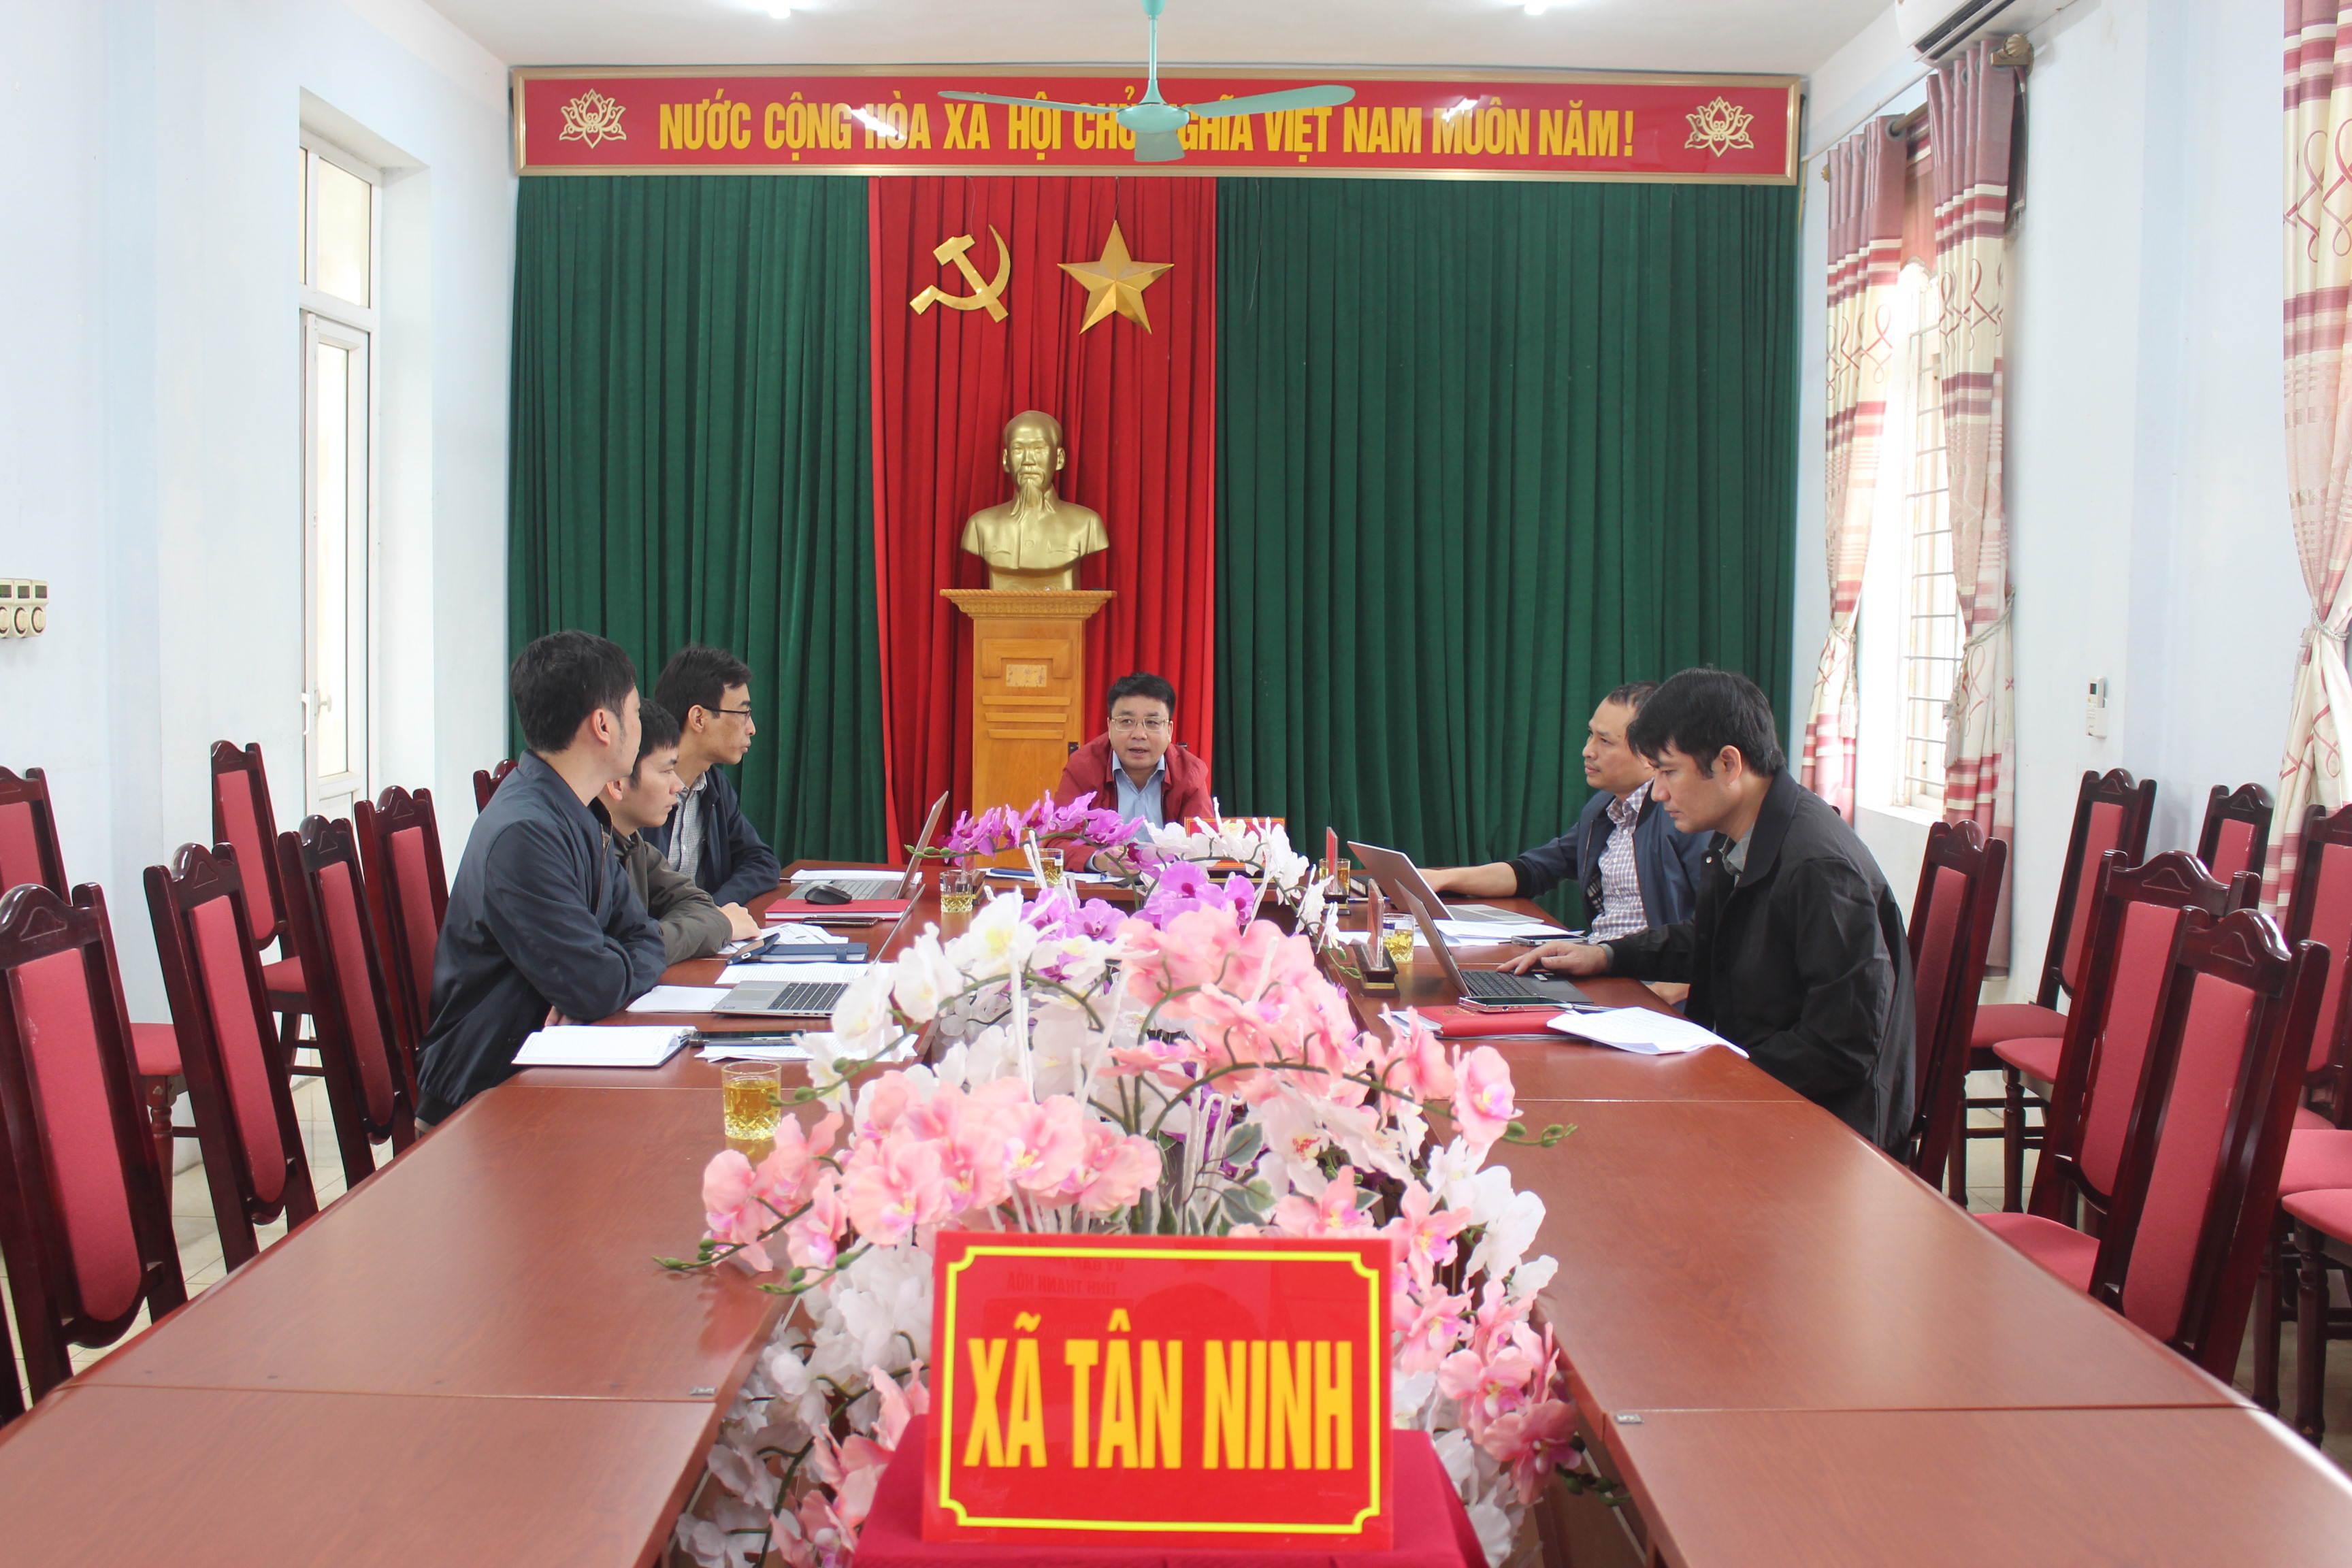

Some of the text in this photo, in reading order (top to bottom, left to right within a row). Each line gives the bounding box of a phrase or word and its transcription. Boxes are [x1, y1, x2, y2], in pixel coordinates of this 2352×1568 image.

[659, 88, 751, 150] NƯỚC
[764, 91, 853, 161] CỘNG
[864, 90, 932, 150] HÒA
[1007, 91, 1062, 161] HỘI
[1166, 94, 1254, 151] GHĨA
[1343, 105, 1422, 154] NAM
[1432, 97, 1531, 155] MUÔN
[1538, 99, 1634, 157] NĂM!
[963, 1308, 1354, 1470] XÃ TÂN NINH
